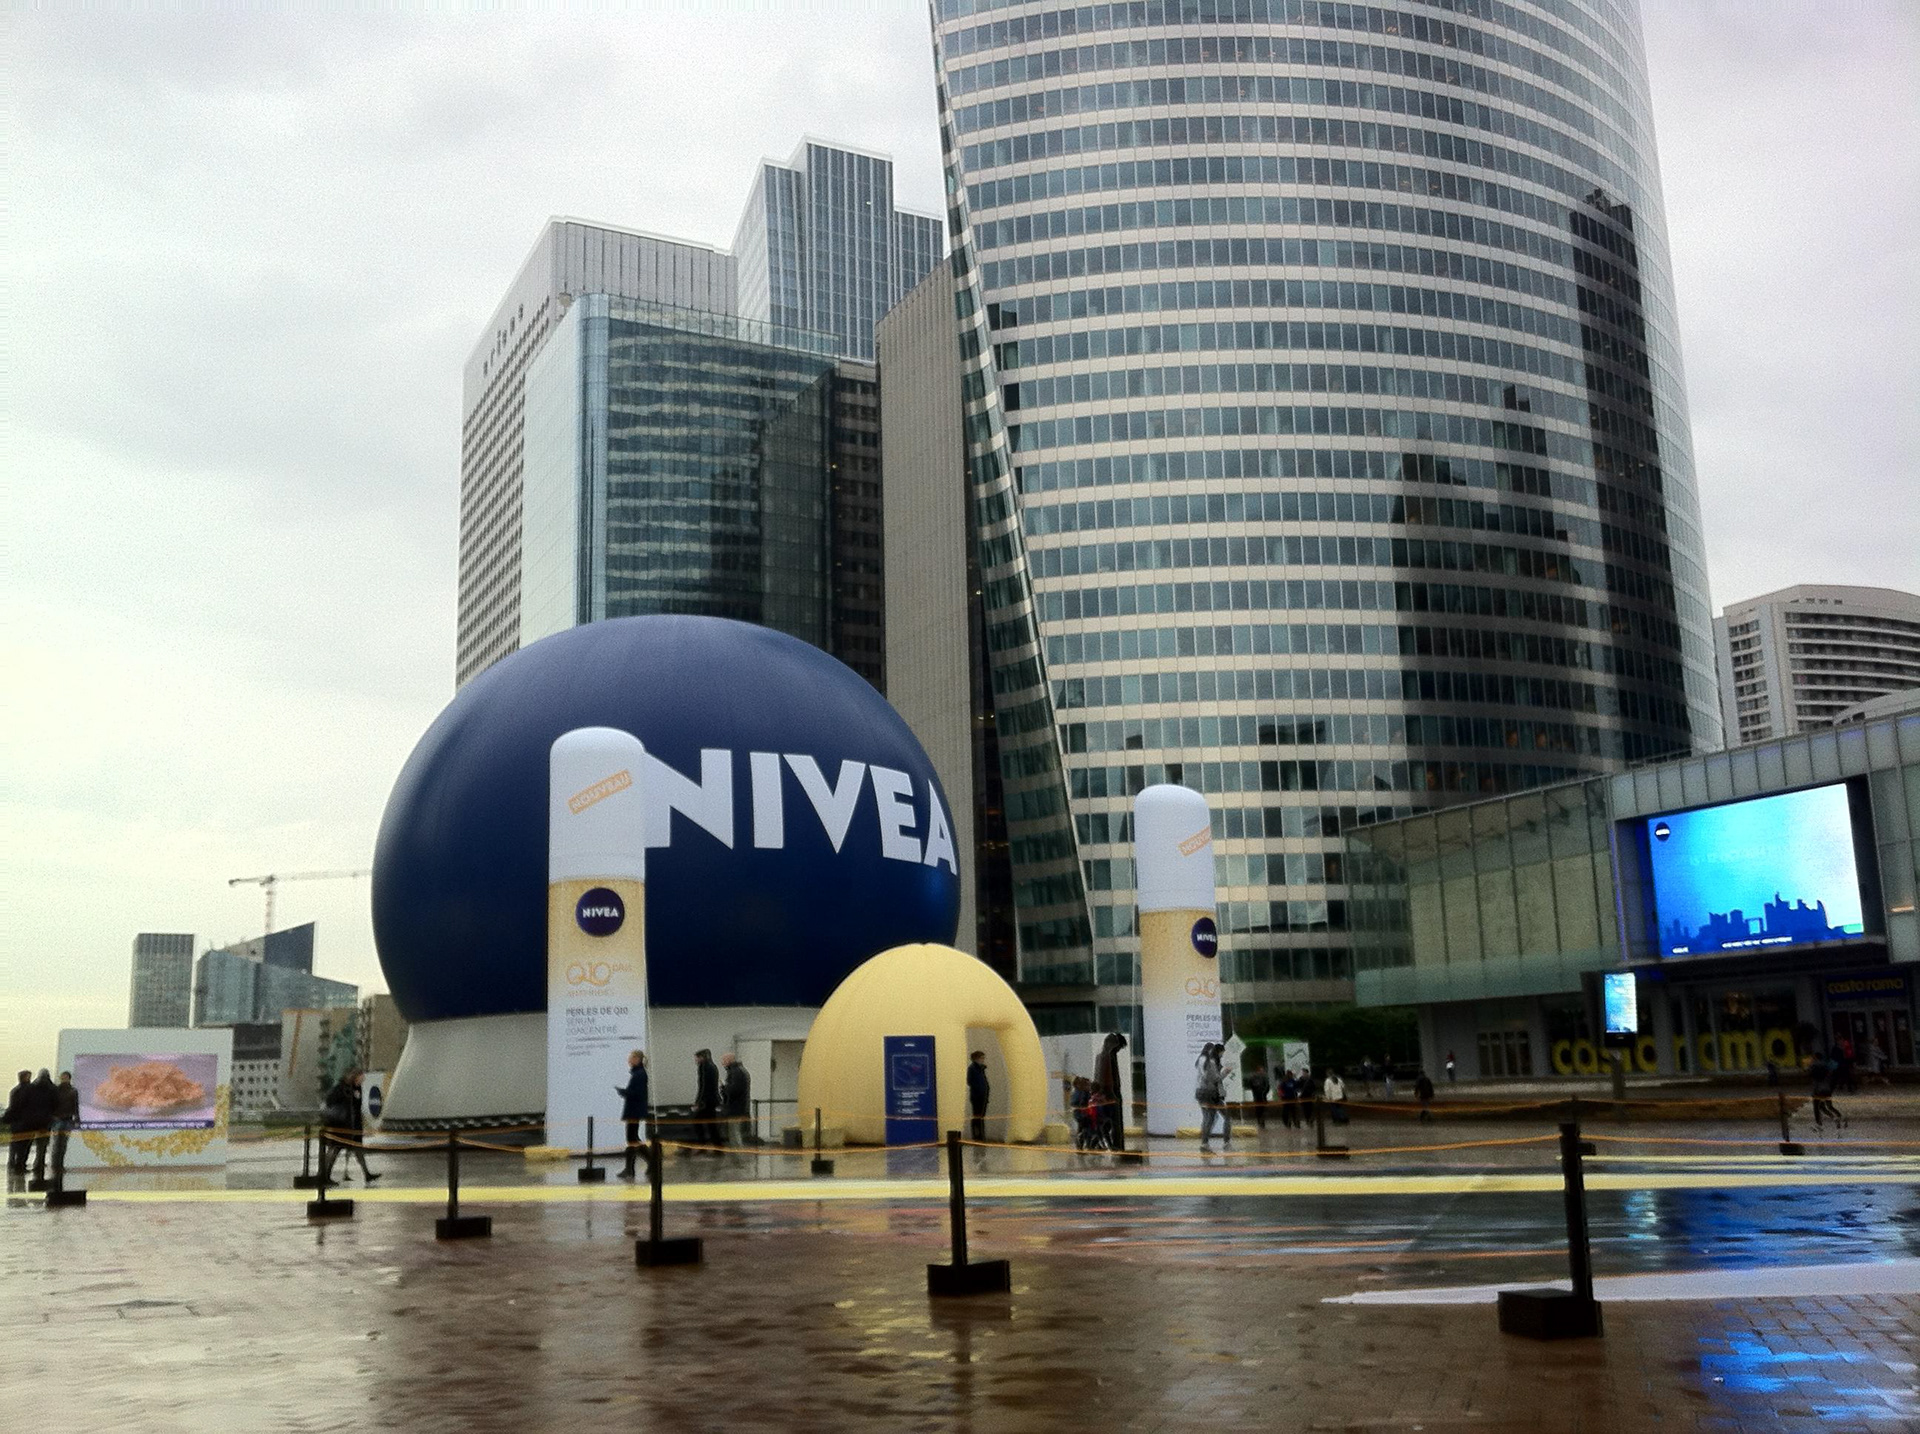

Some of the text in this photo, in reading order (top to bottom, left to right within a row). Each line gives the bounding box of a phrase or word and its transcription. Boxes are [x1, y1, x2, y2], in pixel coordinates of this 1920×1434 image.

[644, 747, 958, 876] NIVEA
[582, 907, 619, 918] NIVEA
[565, 1005, 629, 1017] PERLES DE Q10
